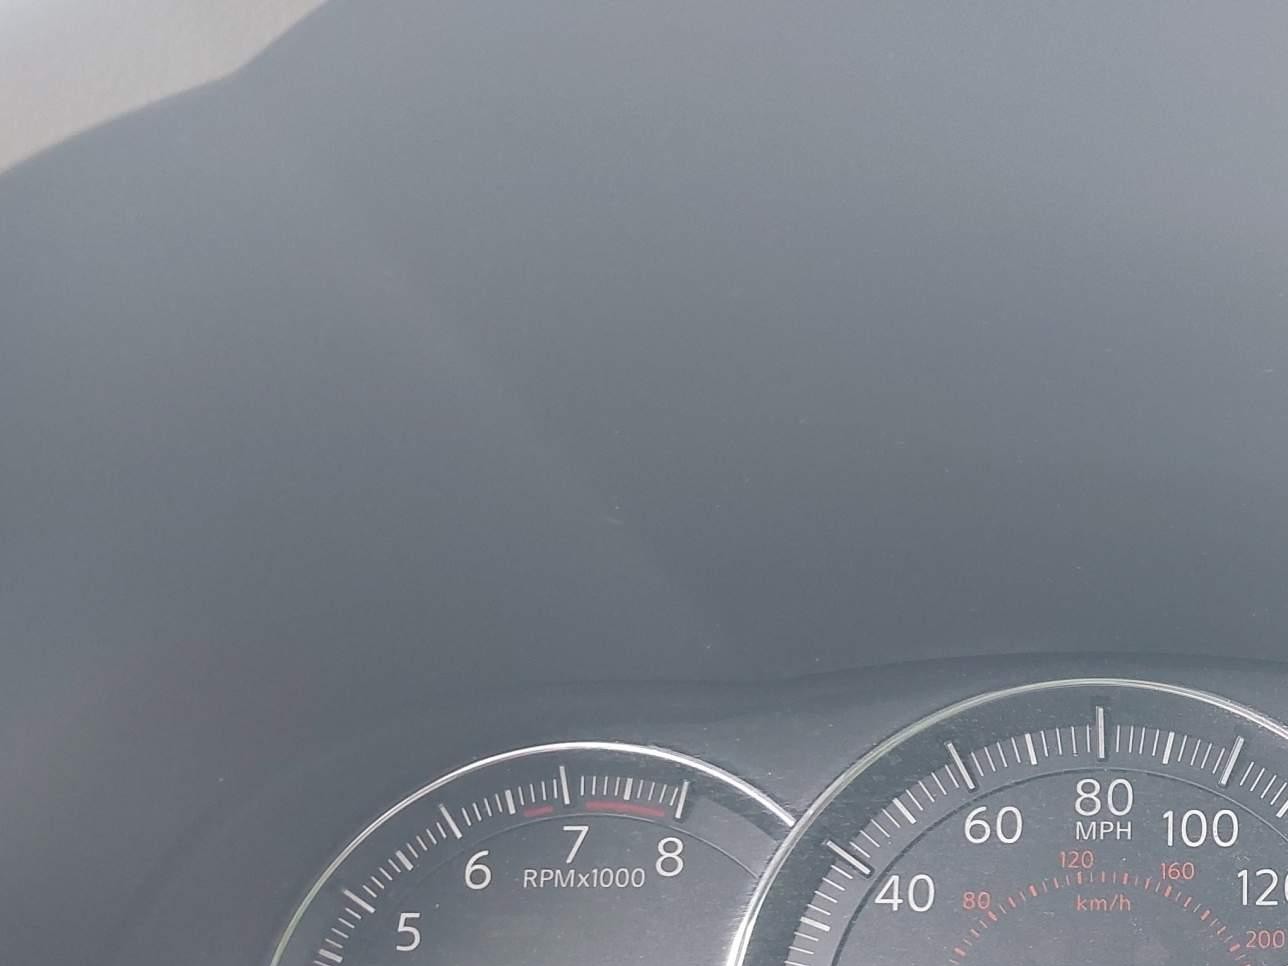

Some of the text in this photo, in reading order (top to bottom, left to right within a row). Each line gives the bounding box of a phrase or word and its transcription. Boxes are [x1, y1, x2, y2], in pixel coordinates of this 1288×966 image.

[1074, 778, 1134, 816] 80
[964, 805, 1023, 843] 60
[1075, 820, 1133, 840] MPH
[1162, 810, 1240, 847] 100
[562, 825, 590, 863] 7
[656, 838, 684, 877] 8
[1060, 851, 1094, 869] 120
[465, 850, 492, 890] 6
[522, 868, 646, 890] RPMx1000
[1161, 863, 1195, 881] 160
[875, 874, 935, 911] 40
[962, 891, 990, 910] 80
[1076, 893, 1132, 913] km/h
[396, 911, 421, 951] 5
[1246, 931, 1286, 949] 200
